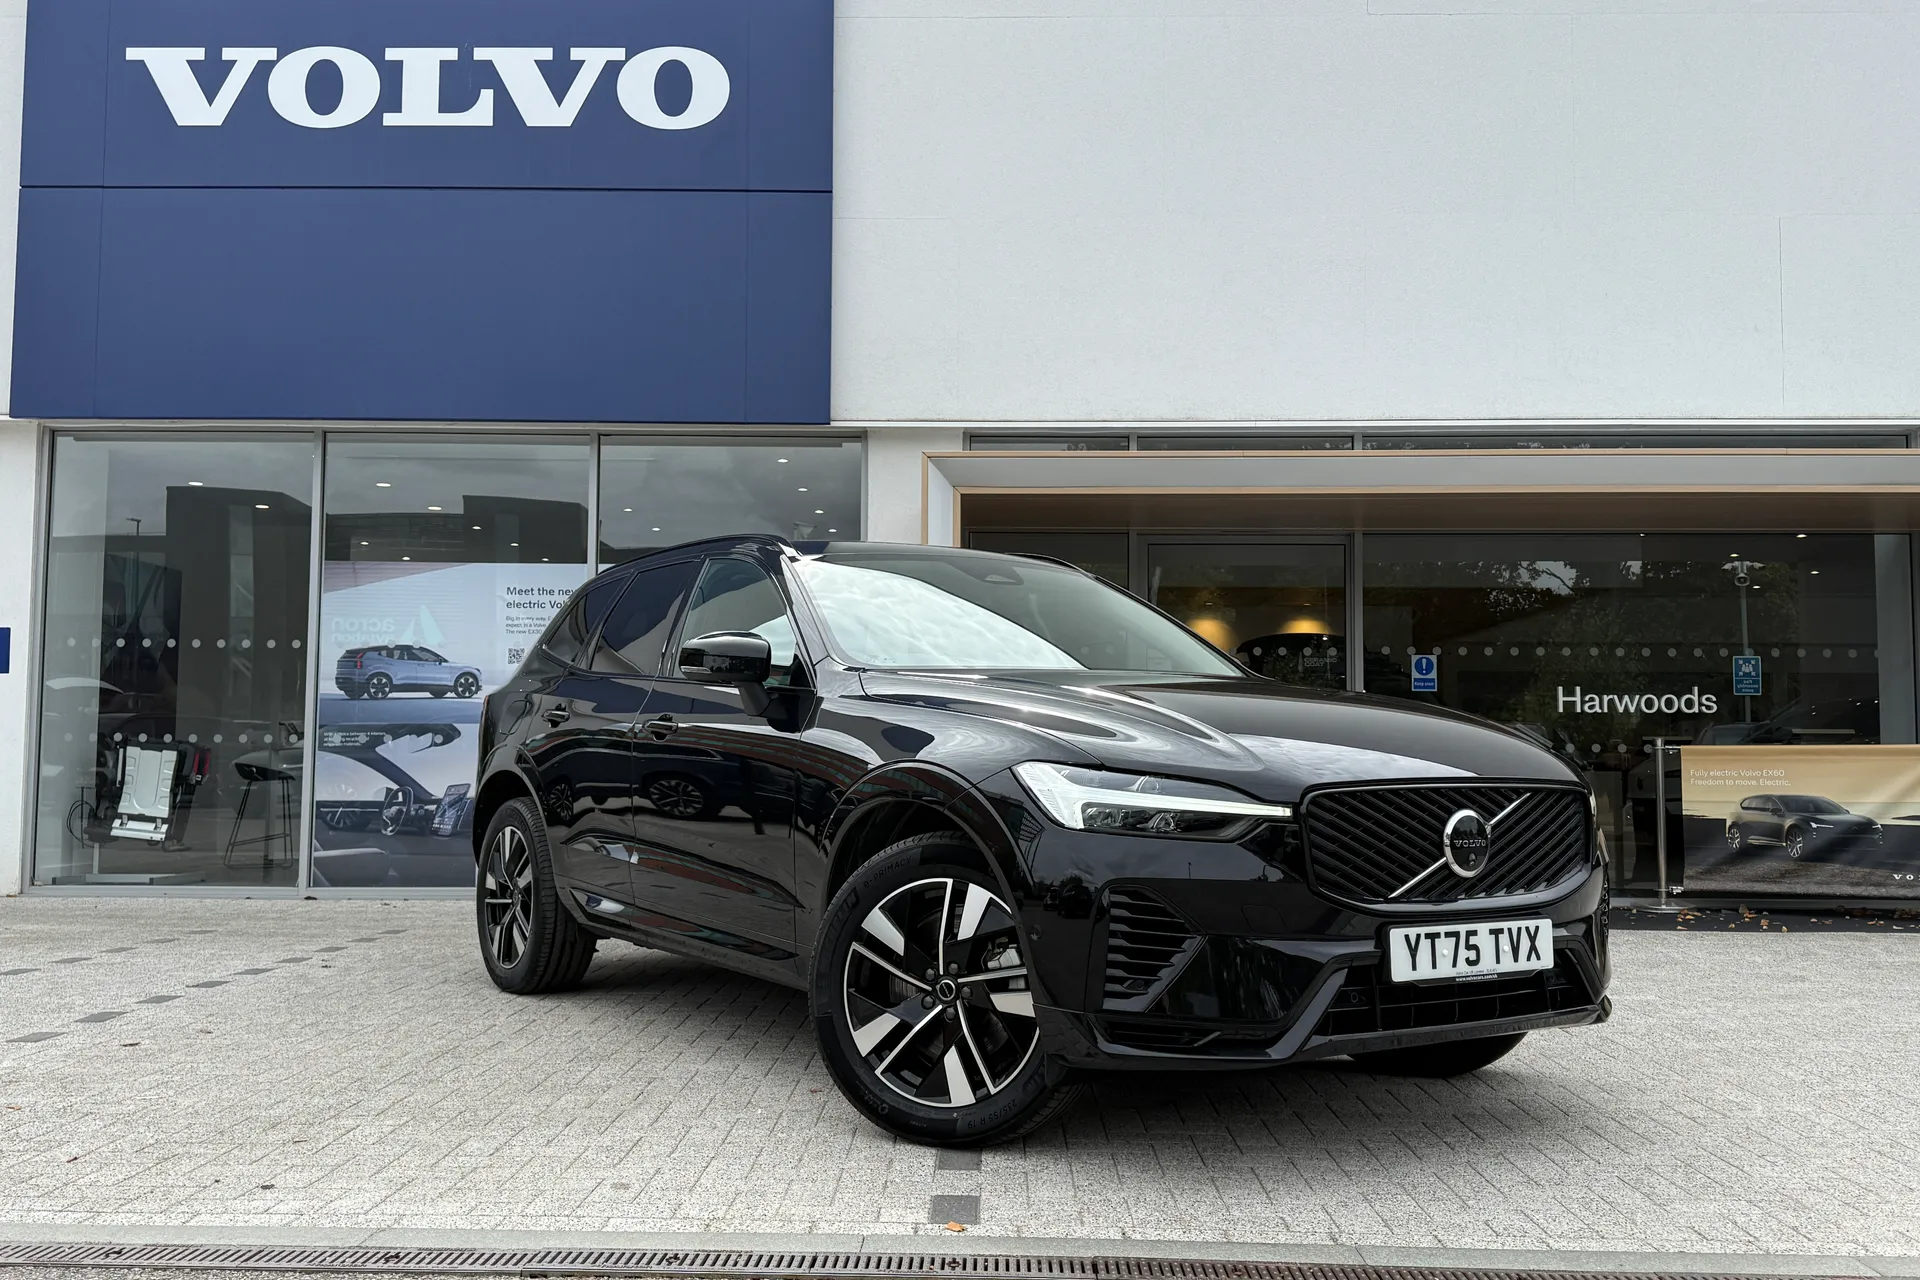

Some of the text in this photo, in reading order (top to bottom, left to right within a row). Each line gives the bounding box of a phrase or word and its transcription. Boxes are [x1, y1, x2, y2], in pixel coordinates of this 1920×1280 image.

[125, 45, 731, 130] VOLVO
[506, 586, 535, 596] Meet
[537, 586, 555, 596] the
[506, 599, 546, 609] electric
[1556, 685, 1718, 714] Harwoods
[1690, 769, 1785, 778] Fully electric Volvo EX60
[1690, 778, 1724, 786] Freedom
[1759, 778, 1792, 786] Electric.
[1453, 839, 1486, 848] VOLVO
[1892, 873, 1920, 881] VO
[1404, 925, 1542, 972] YT75 TVX
